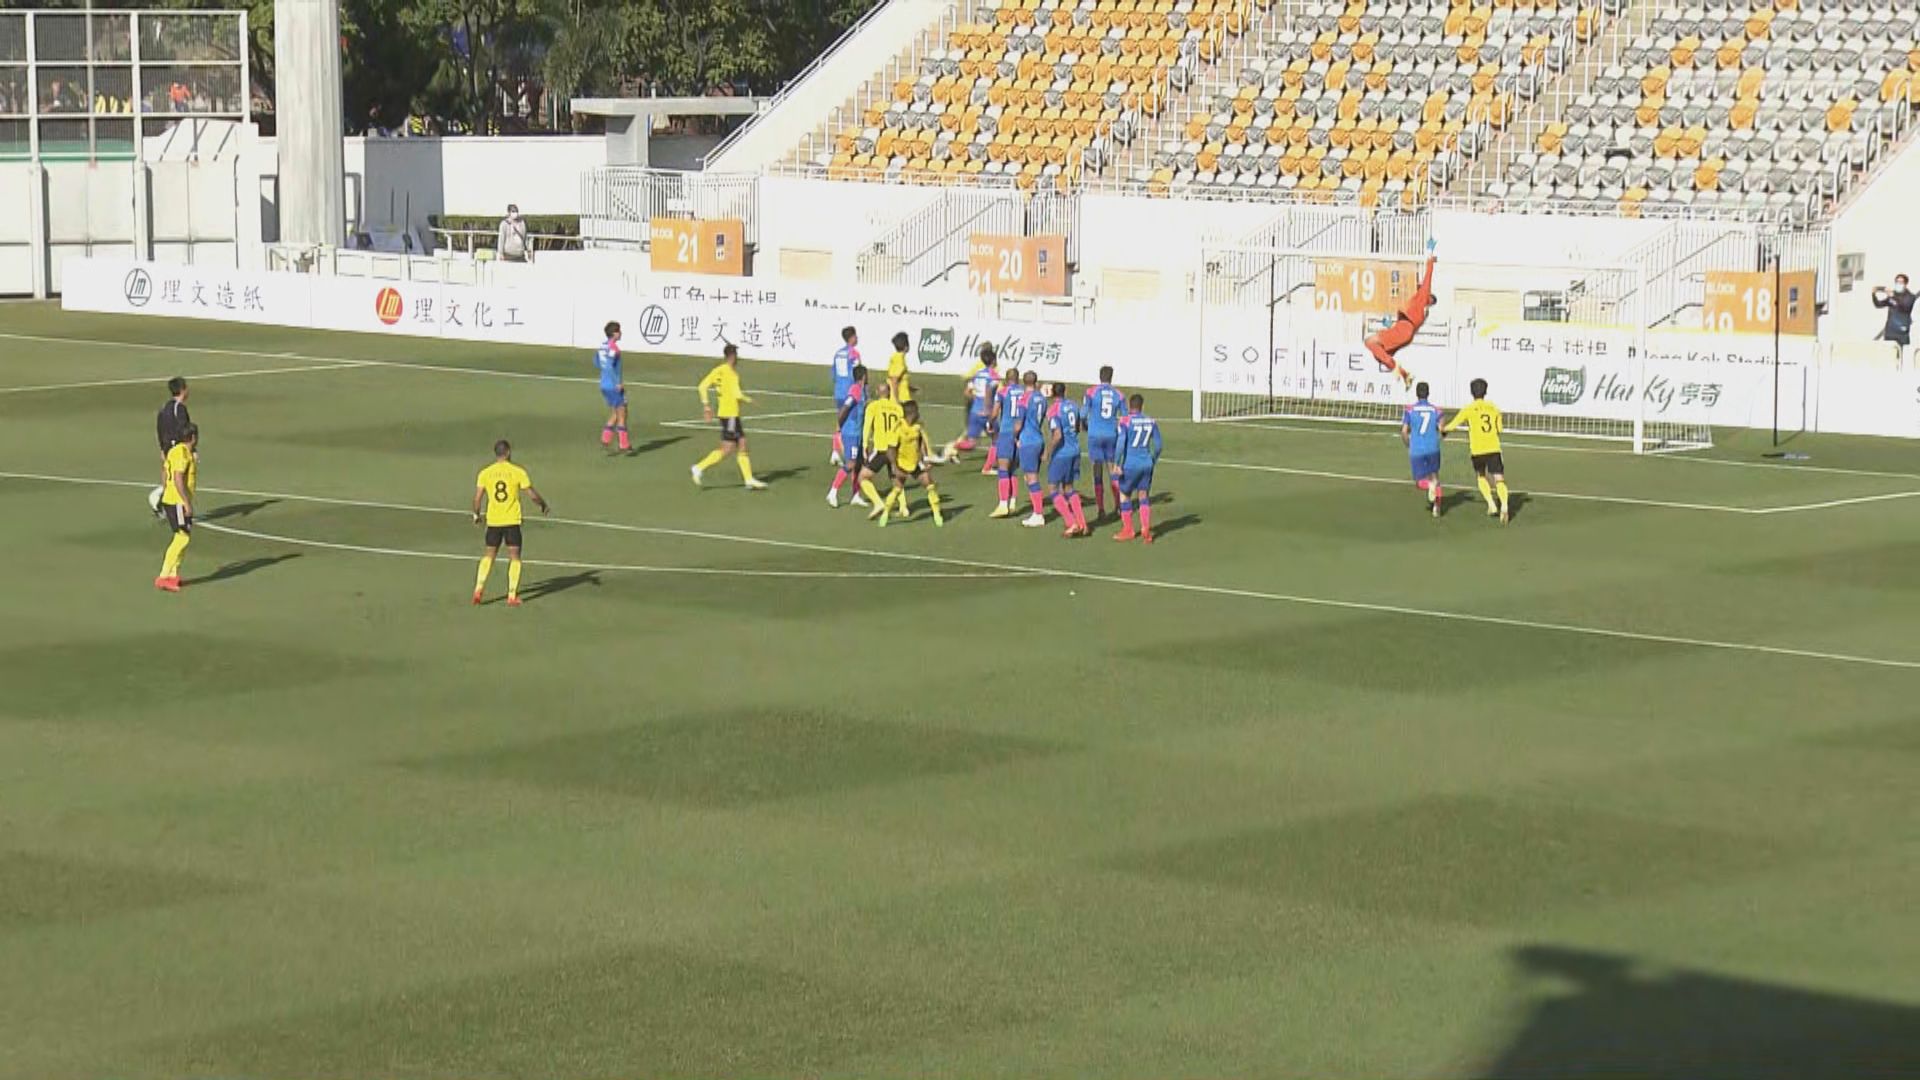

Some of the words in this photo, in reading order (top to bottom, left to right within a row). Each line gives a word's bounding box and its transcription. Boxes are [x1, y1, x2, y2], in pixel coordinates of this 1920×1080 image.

[677, 232, 698, 264] 21
[998, 249, 1023, 281] 20
[162, 279, 264, 311] 理文造紙
[1349, 268, 1376, 302] 19
[413, 298, 525, 327] 理文化工
[1741, 287, 1772, 322] 18
[679, 315, 796, 350] 理文造紙
[882, 411, 899, 433] 10
[1101, 398, 1113, 419] 5
[1419, 411, 1431, 435] 7
[1131, 425, 1153, 448] 77
[1480, 414, 1492, 433] 3
[495, 480, 508, 503] 8
